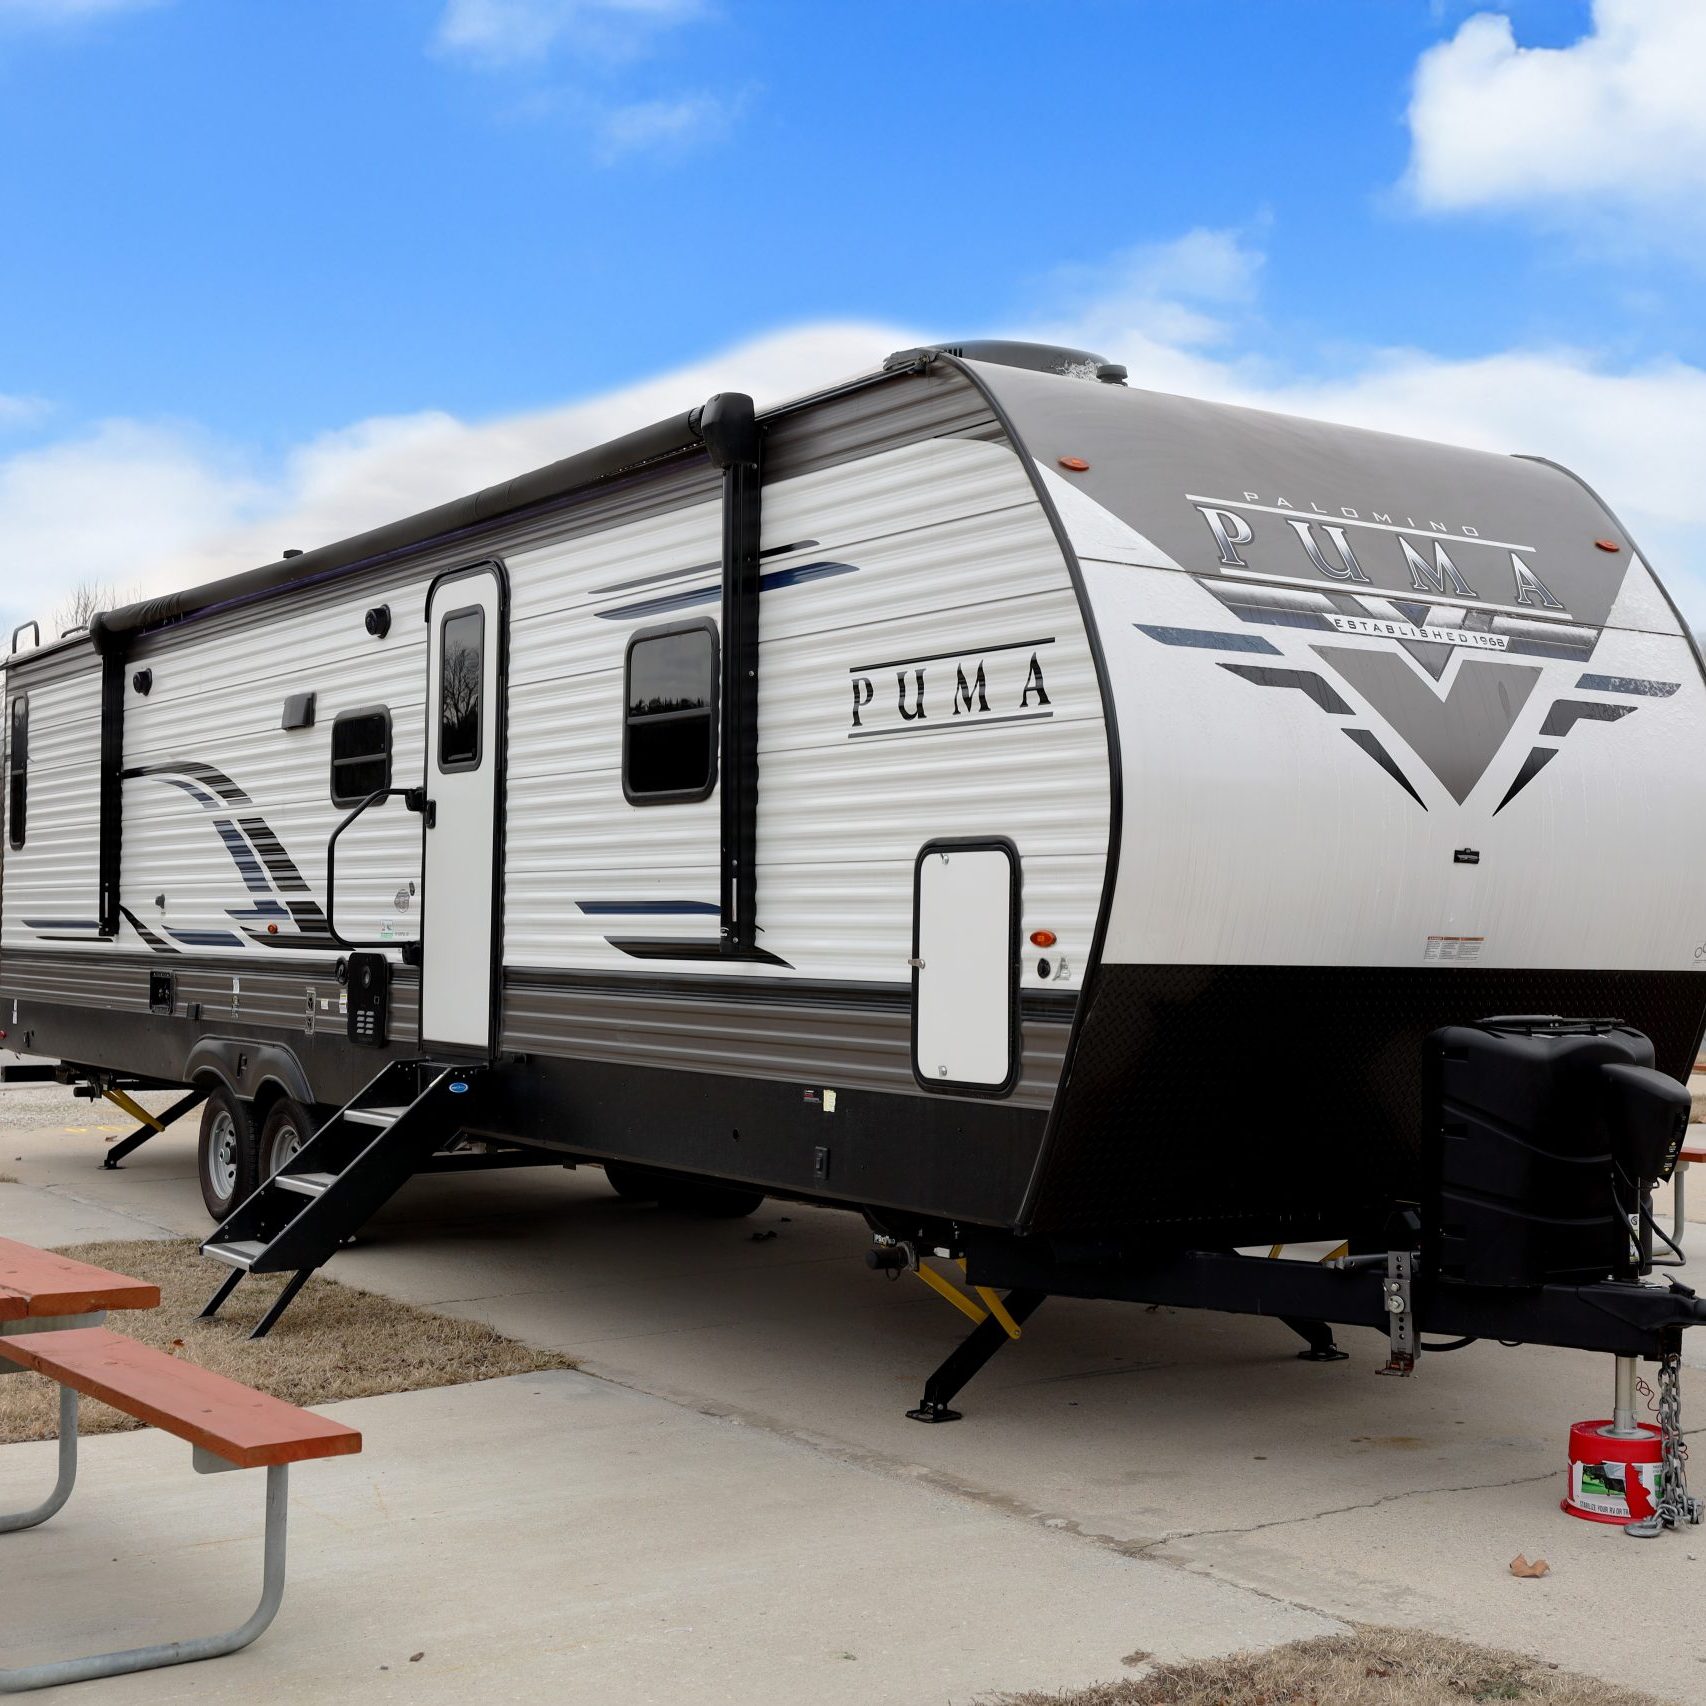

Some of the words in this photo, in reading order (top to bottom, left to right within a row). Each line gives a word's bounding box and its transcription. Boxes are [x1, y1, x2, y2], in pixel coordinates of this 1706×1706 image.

[1243, 491, 1479, 536] PALOMINO
[1195, 504, 1564, 609] PUMA
[1334, 619, 1467, 643] ESTABLISHED
[1472, 635, 1506, 647] 1968
[851, 651, 1051, 727] PUMA
